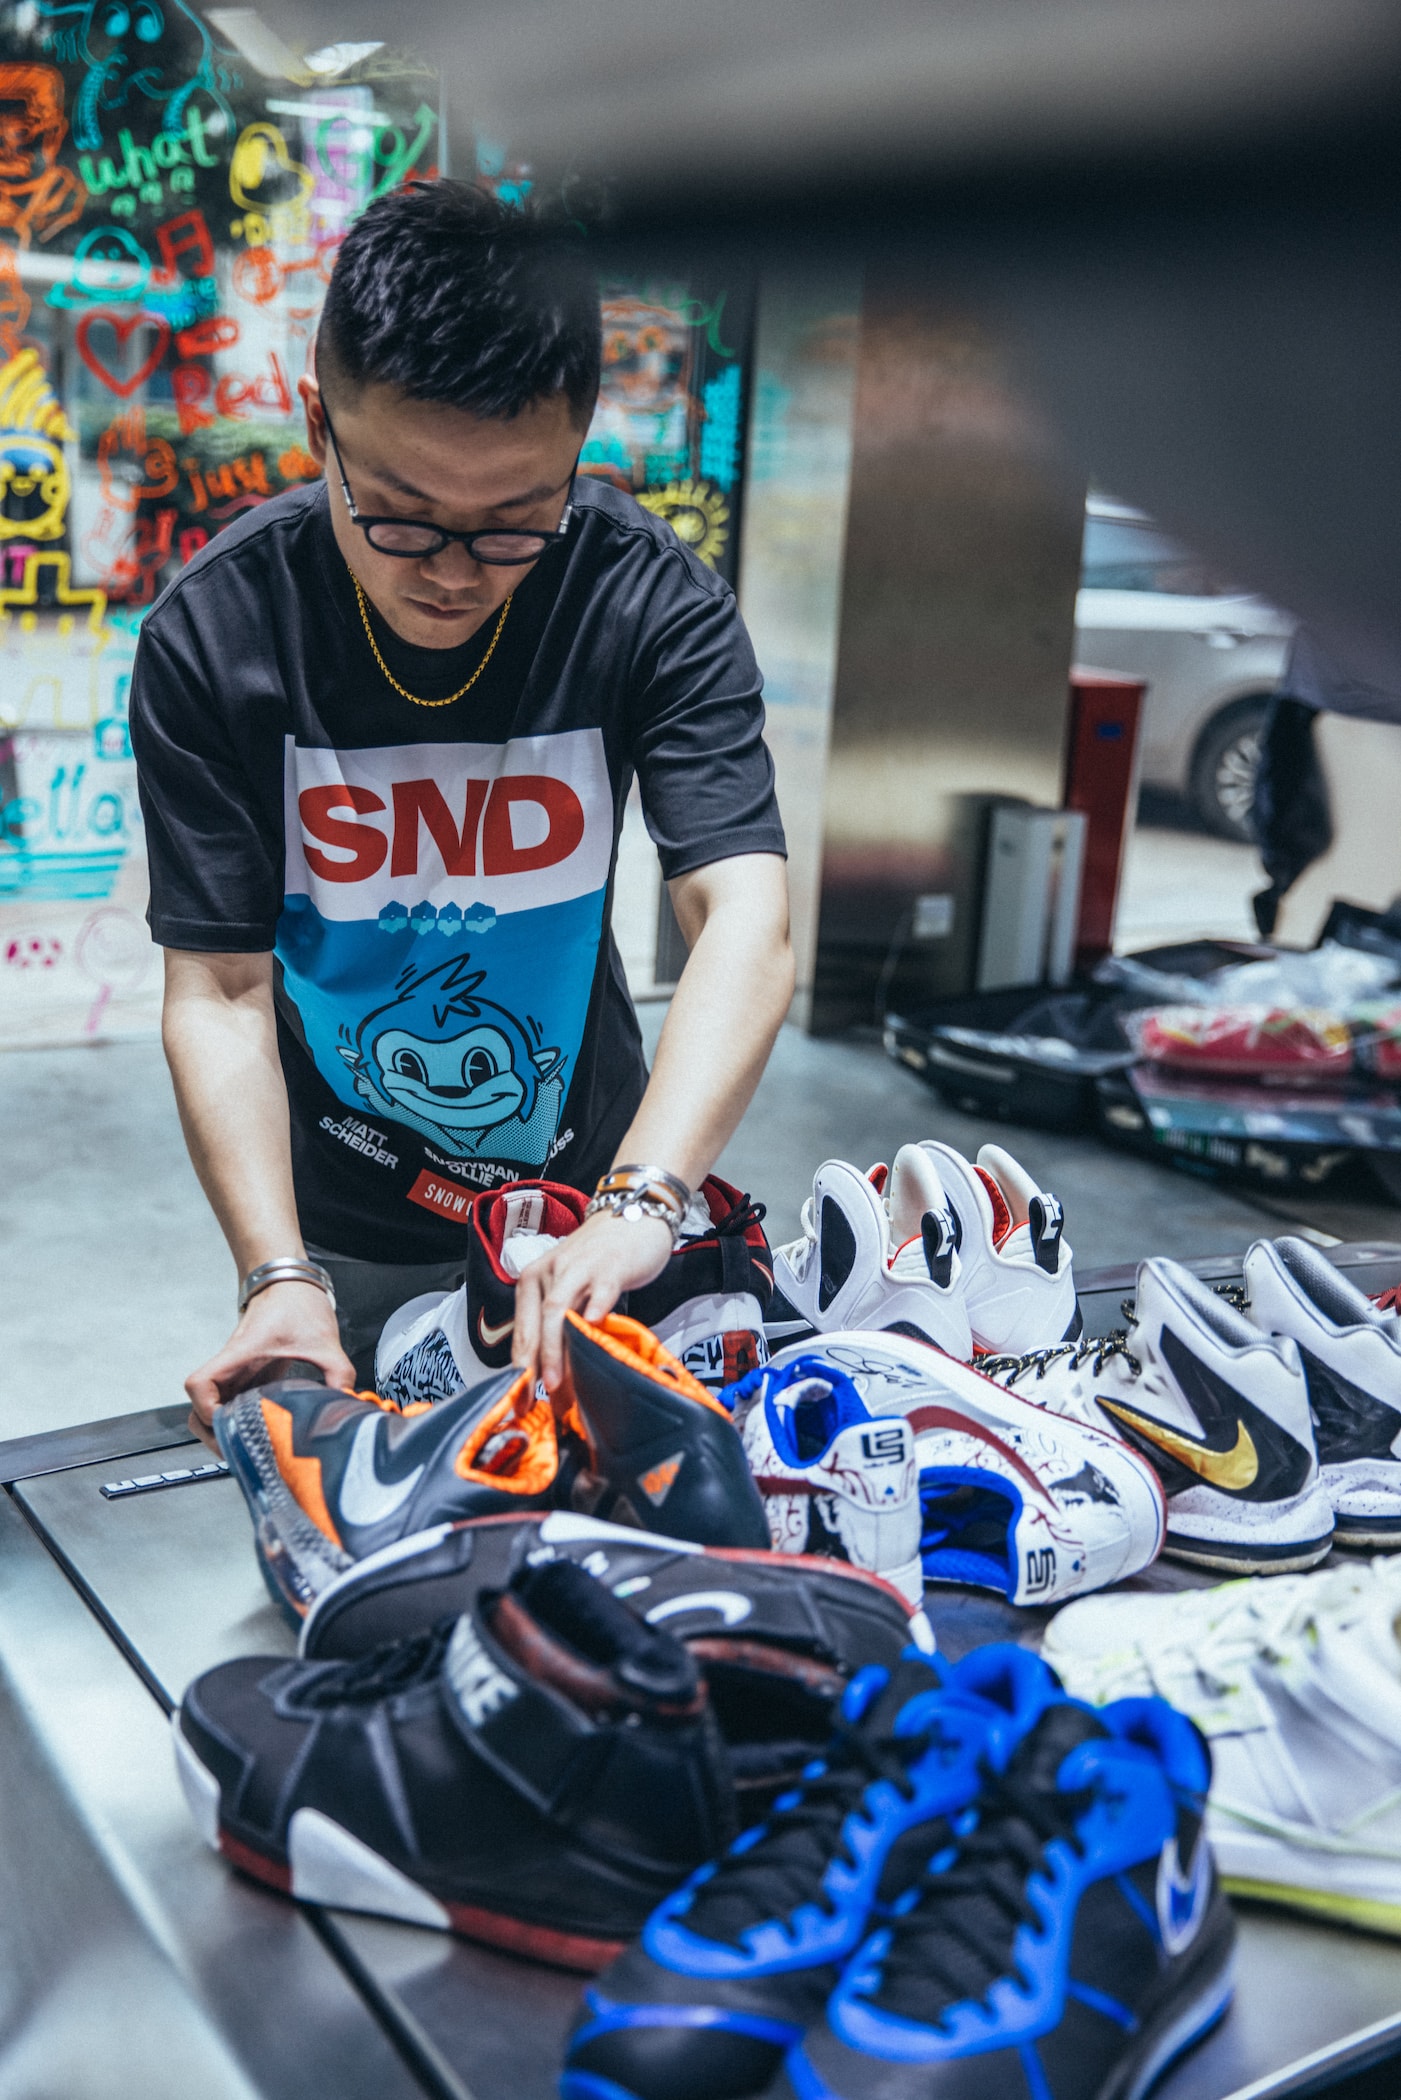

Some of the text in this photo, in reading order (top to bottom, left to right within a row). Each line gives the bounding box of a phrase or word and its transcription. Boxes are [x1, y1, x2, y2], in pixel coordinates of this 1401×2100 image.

[78, 105, 218, 196] what
[300, 775, 585, 884] SND
[319, 1116, 399, 1170] SCHEIDER
[342, 1115, 388, 1147] MATT
